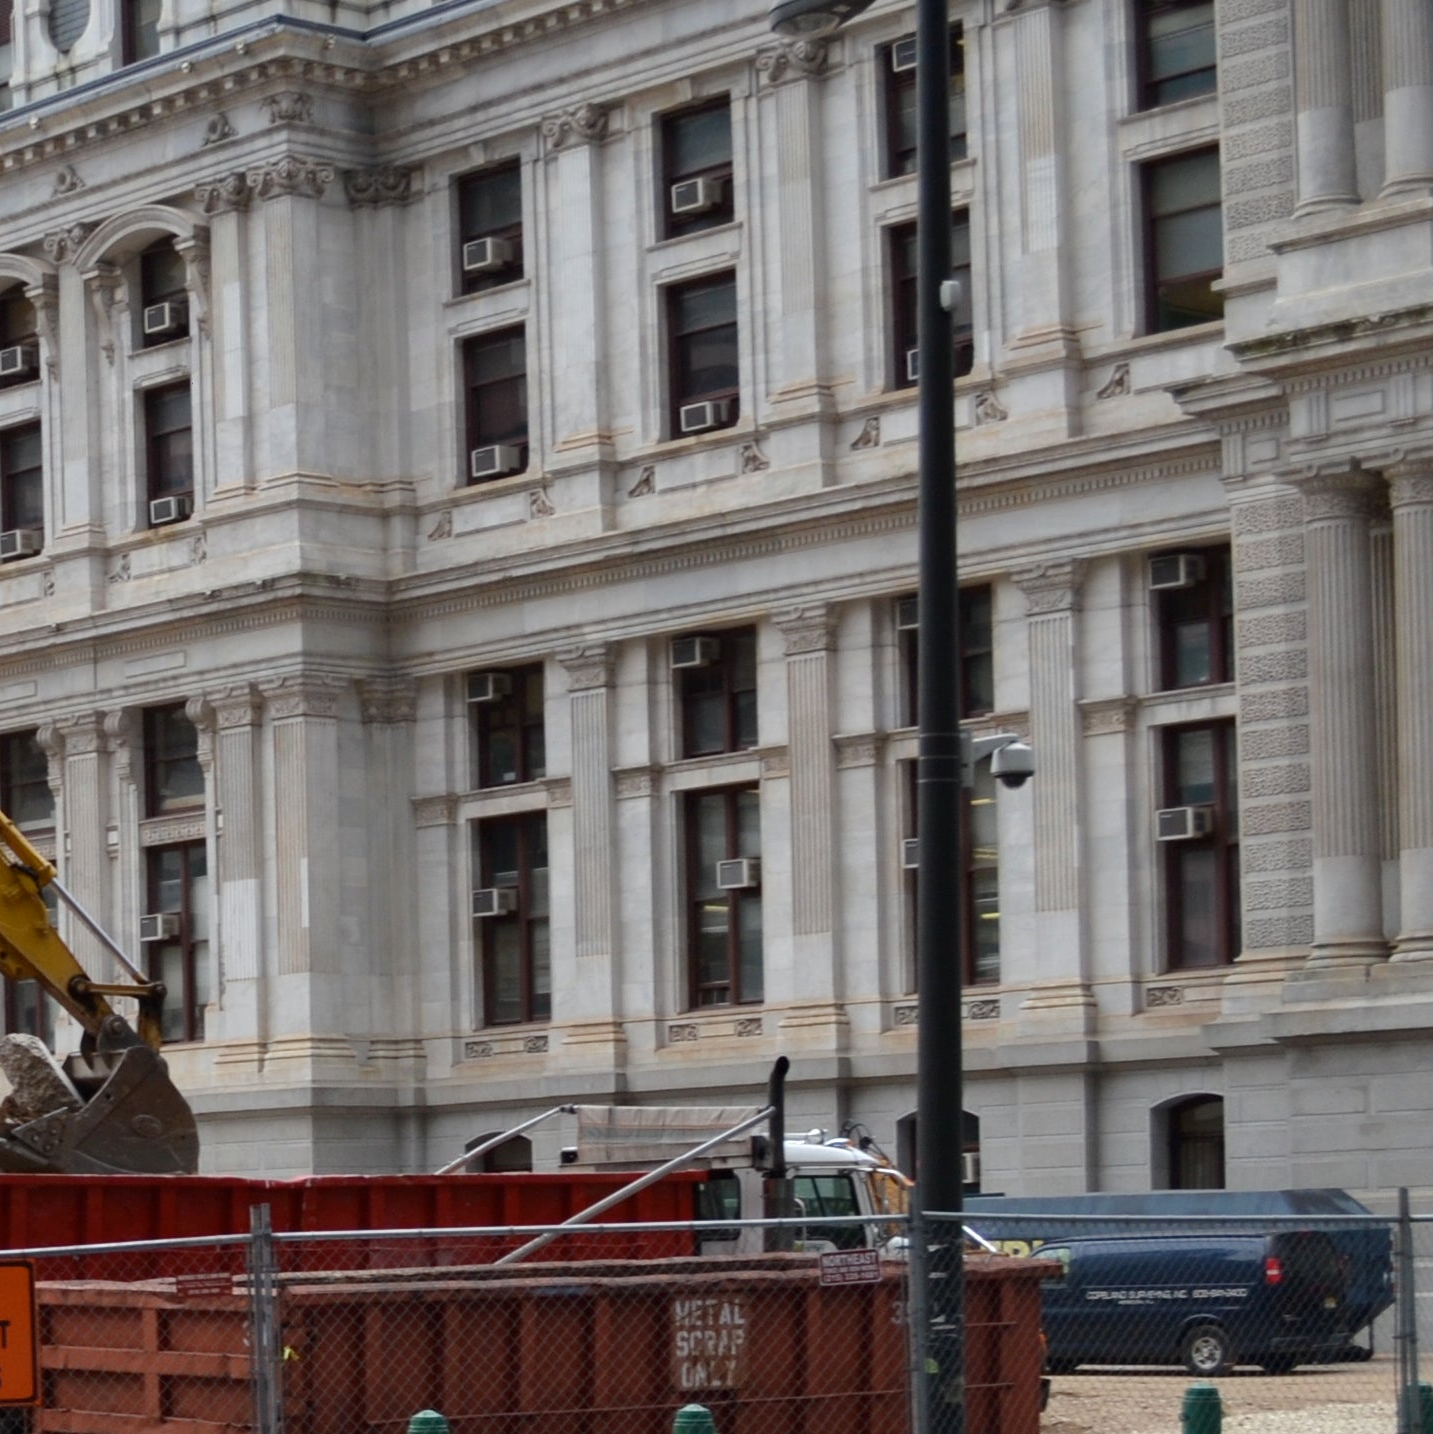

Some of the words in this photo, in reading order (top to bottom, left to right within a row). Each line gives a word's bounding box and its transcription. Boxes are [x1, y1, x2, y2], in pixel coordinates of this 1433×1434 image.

[675, 1299, 745, 1325] METAL
[676, 1329, 745, 1357] SCRAP
[681, 1360, 737, 1388] ONLY
